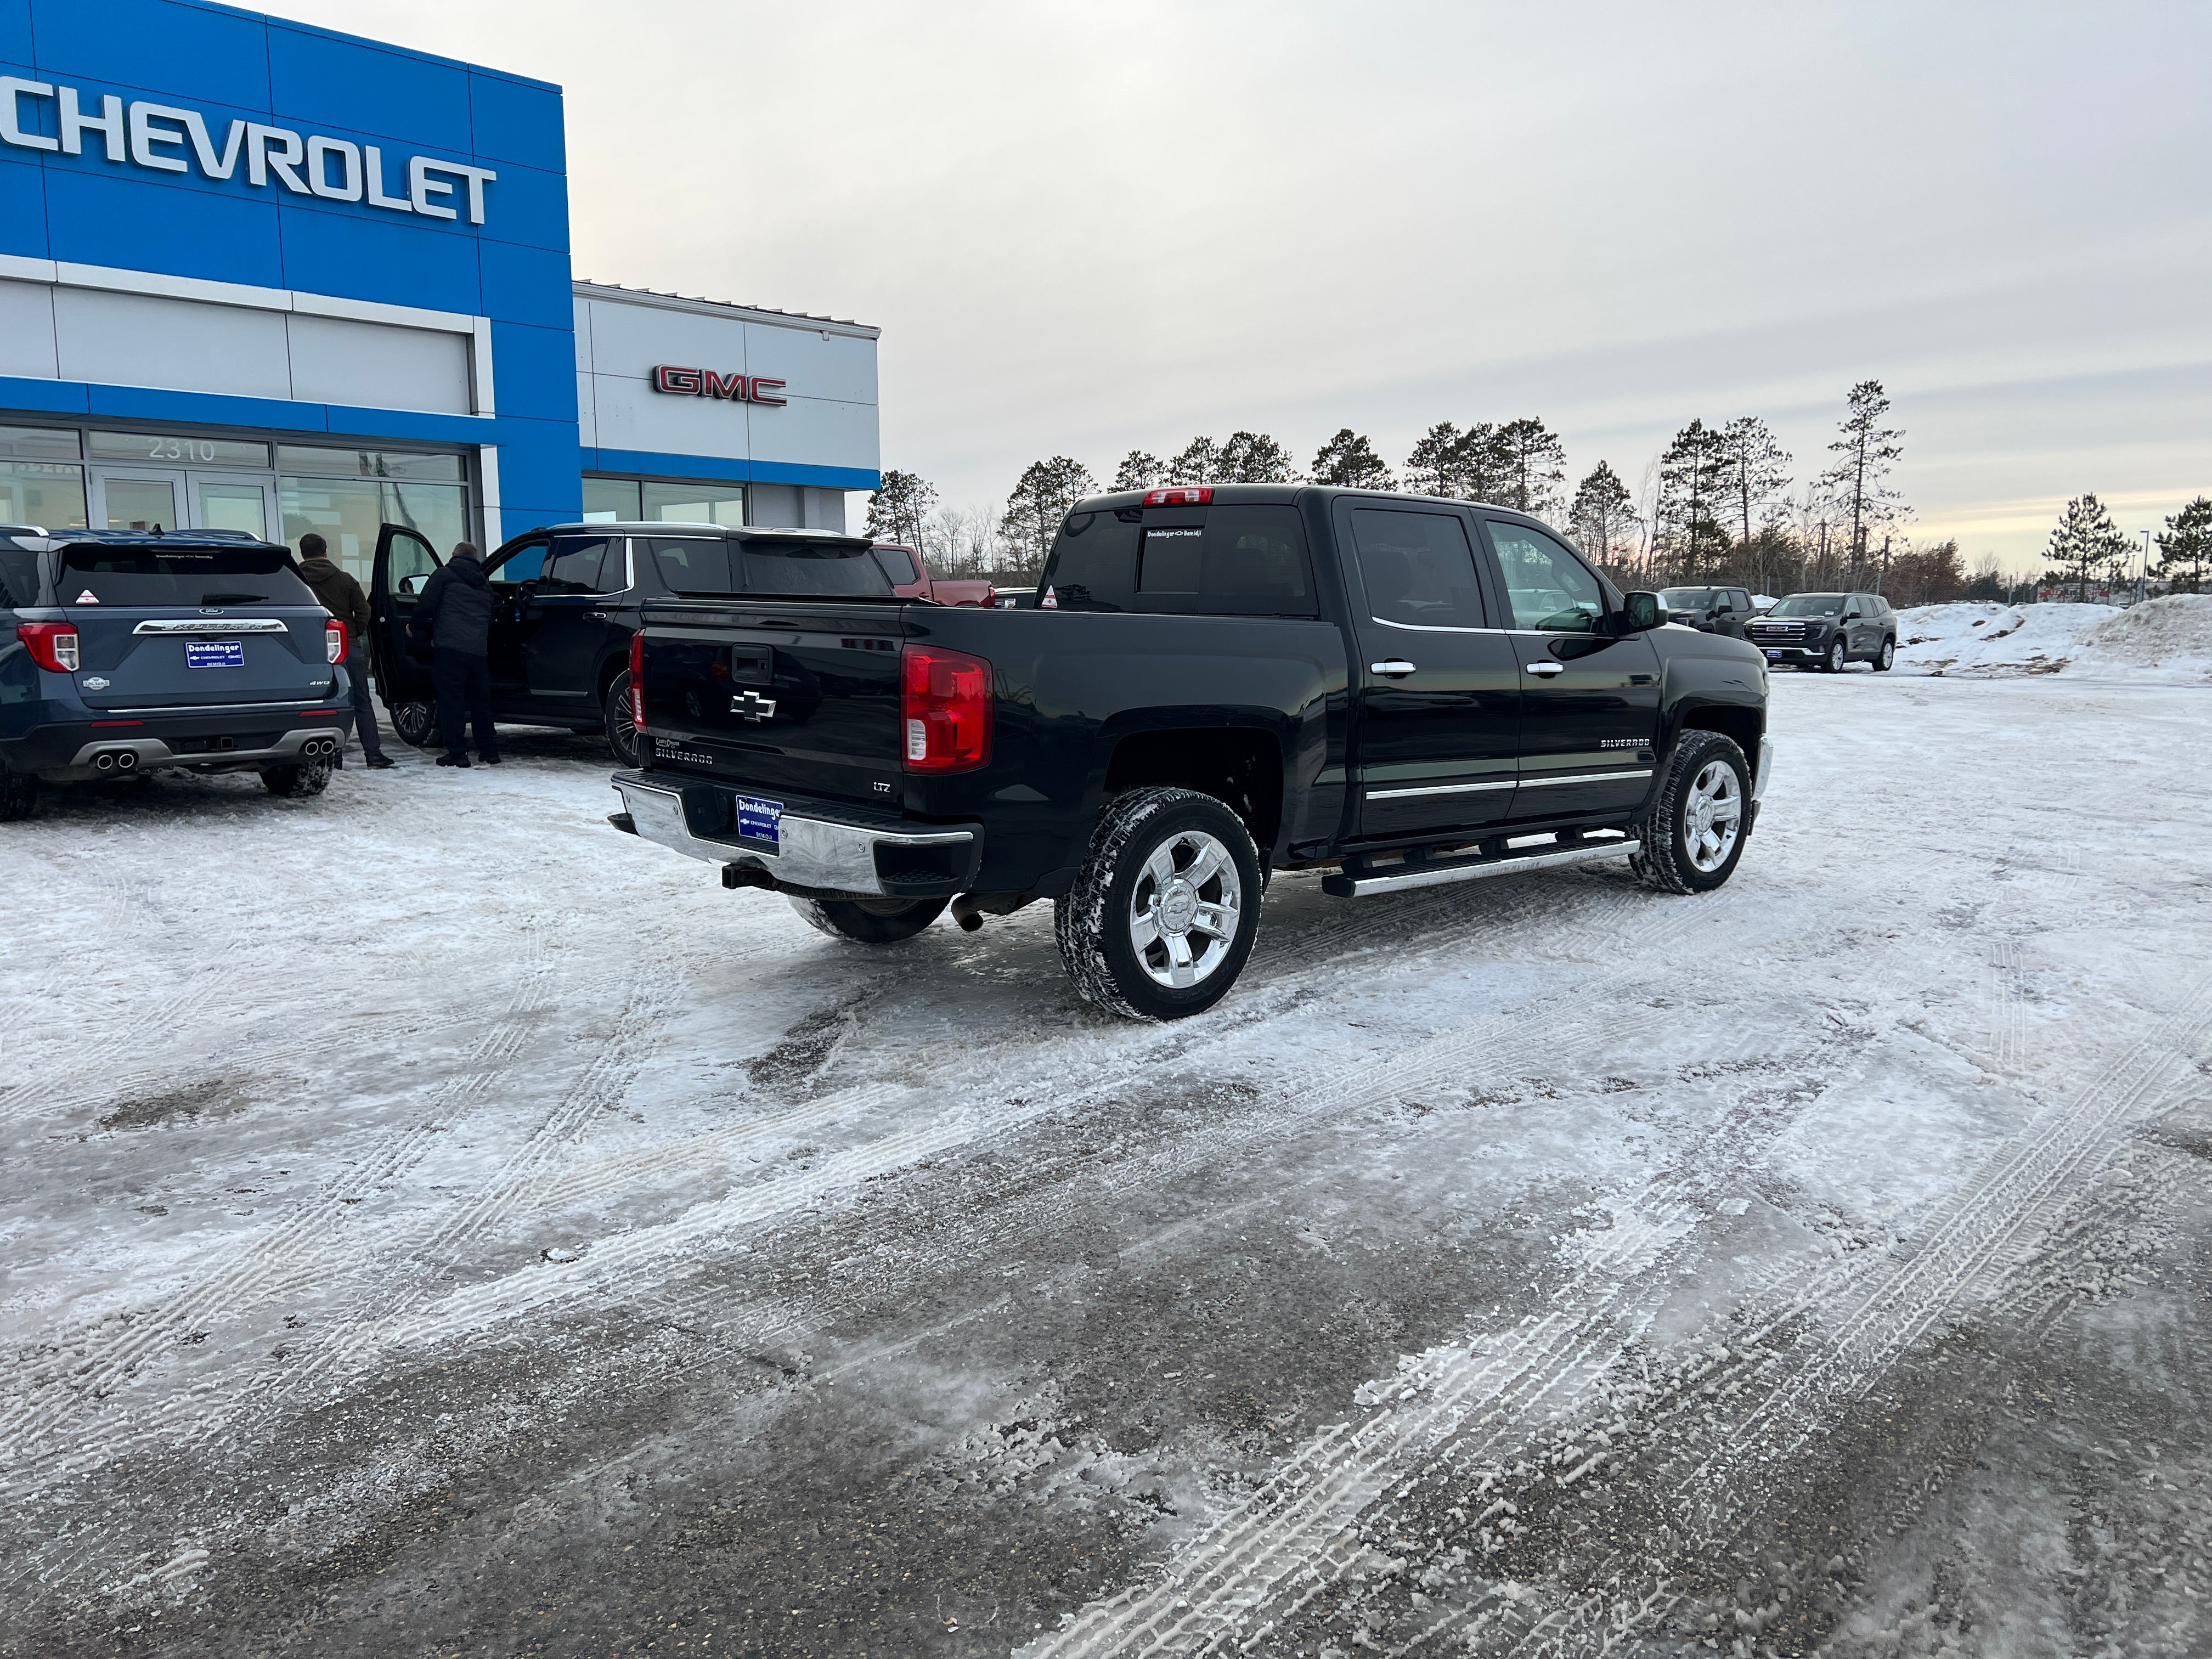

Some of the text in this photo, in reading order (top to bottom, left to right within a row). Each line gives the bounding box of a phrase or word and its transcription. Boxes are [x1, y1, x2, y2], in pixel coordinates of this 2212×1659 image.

[0, 76, 496, 224] CHEVROLET
[653, 364, 787, 406] GMC
[148, 437, 215, 461] 2310
[1147, 531, 1175, 539] Dondelinger
[188, 644, 239, 653] Dondelinger
[1601, 738, 1650, 747] SILVERADO
[656, 748, 713, 764] SILVERADO
[873, 782, 890, 793] LTZ
[751, 820, 772, 828] CHEVROLET
[756, 832, 772, 840] BEMIDJI
